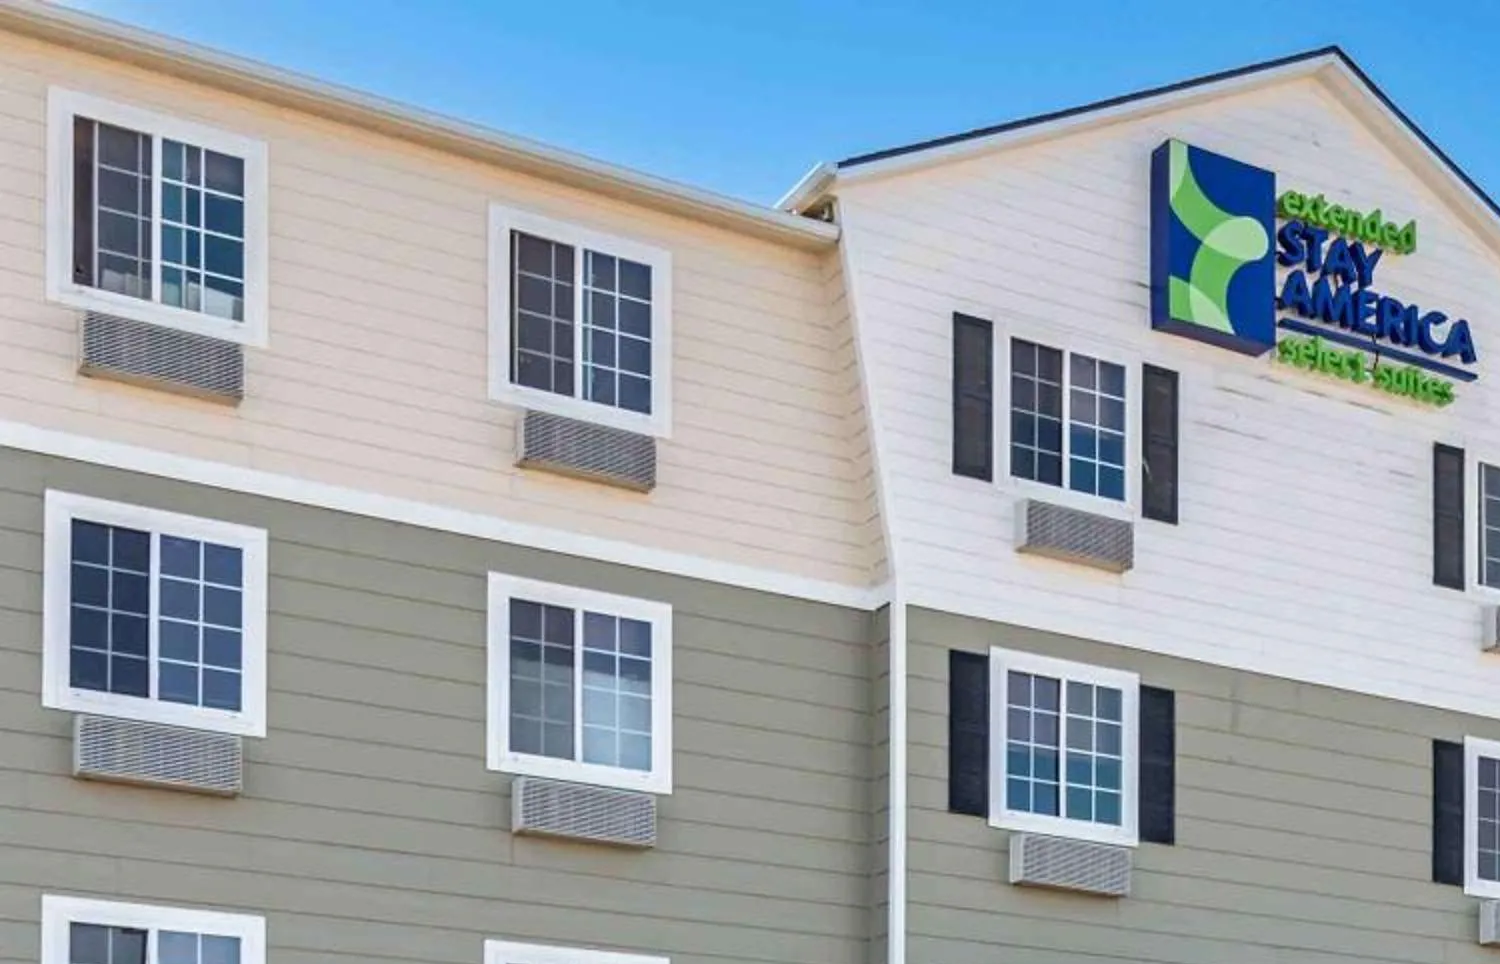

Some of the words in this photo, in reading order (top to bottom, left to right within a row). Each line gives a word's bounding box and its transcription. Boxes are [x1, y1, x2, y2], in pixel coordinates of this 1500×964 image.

[1276, 220, 1383, 289] STAY
[1277, 190, 1417, 254] extended
[1275, 269, 1477, 365] AMERICA
[1277, 335, 1367, 383] select
[1372, 364, 1455, 407] suites
